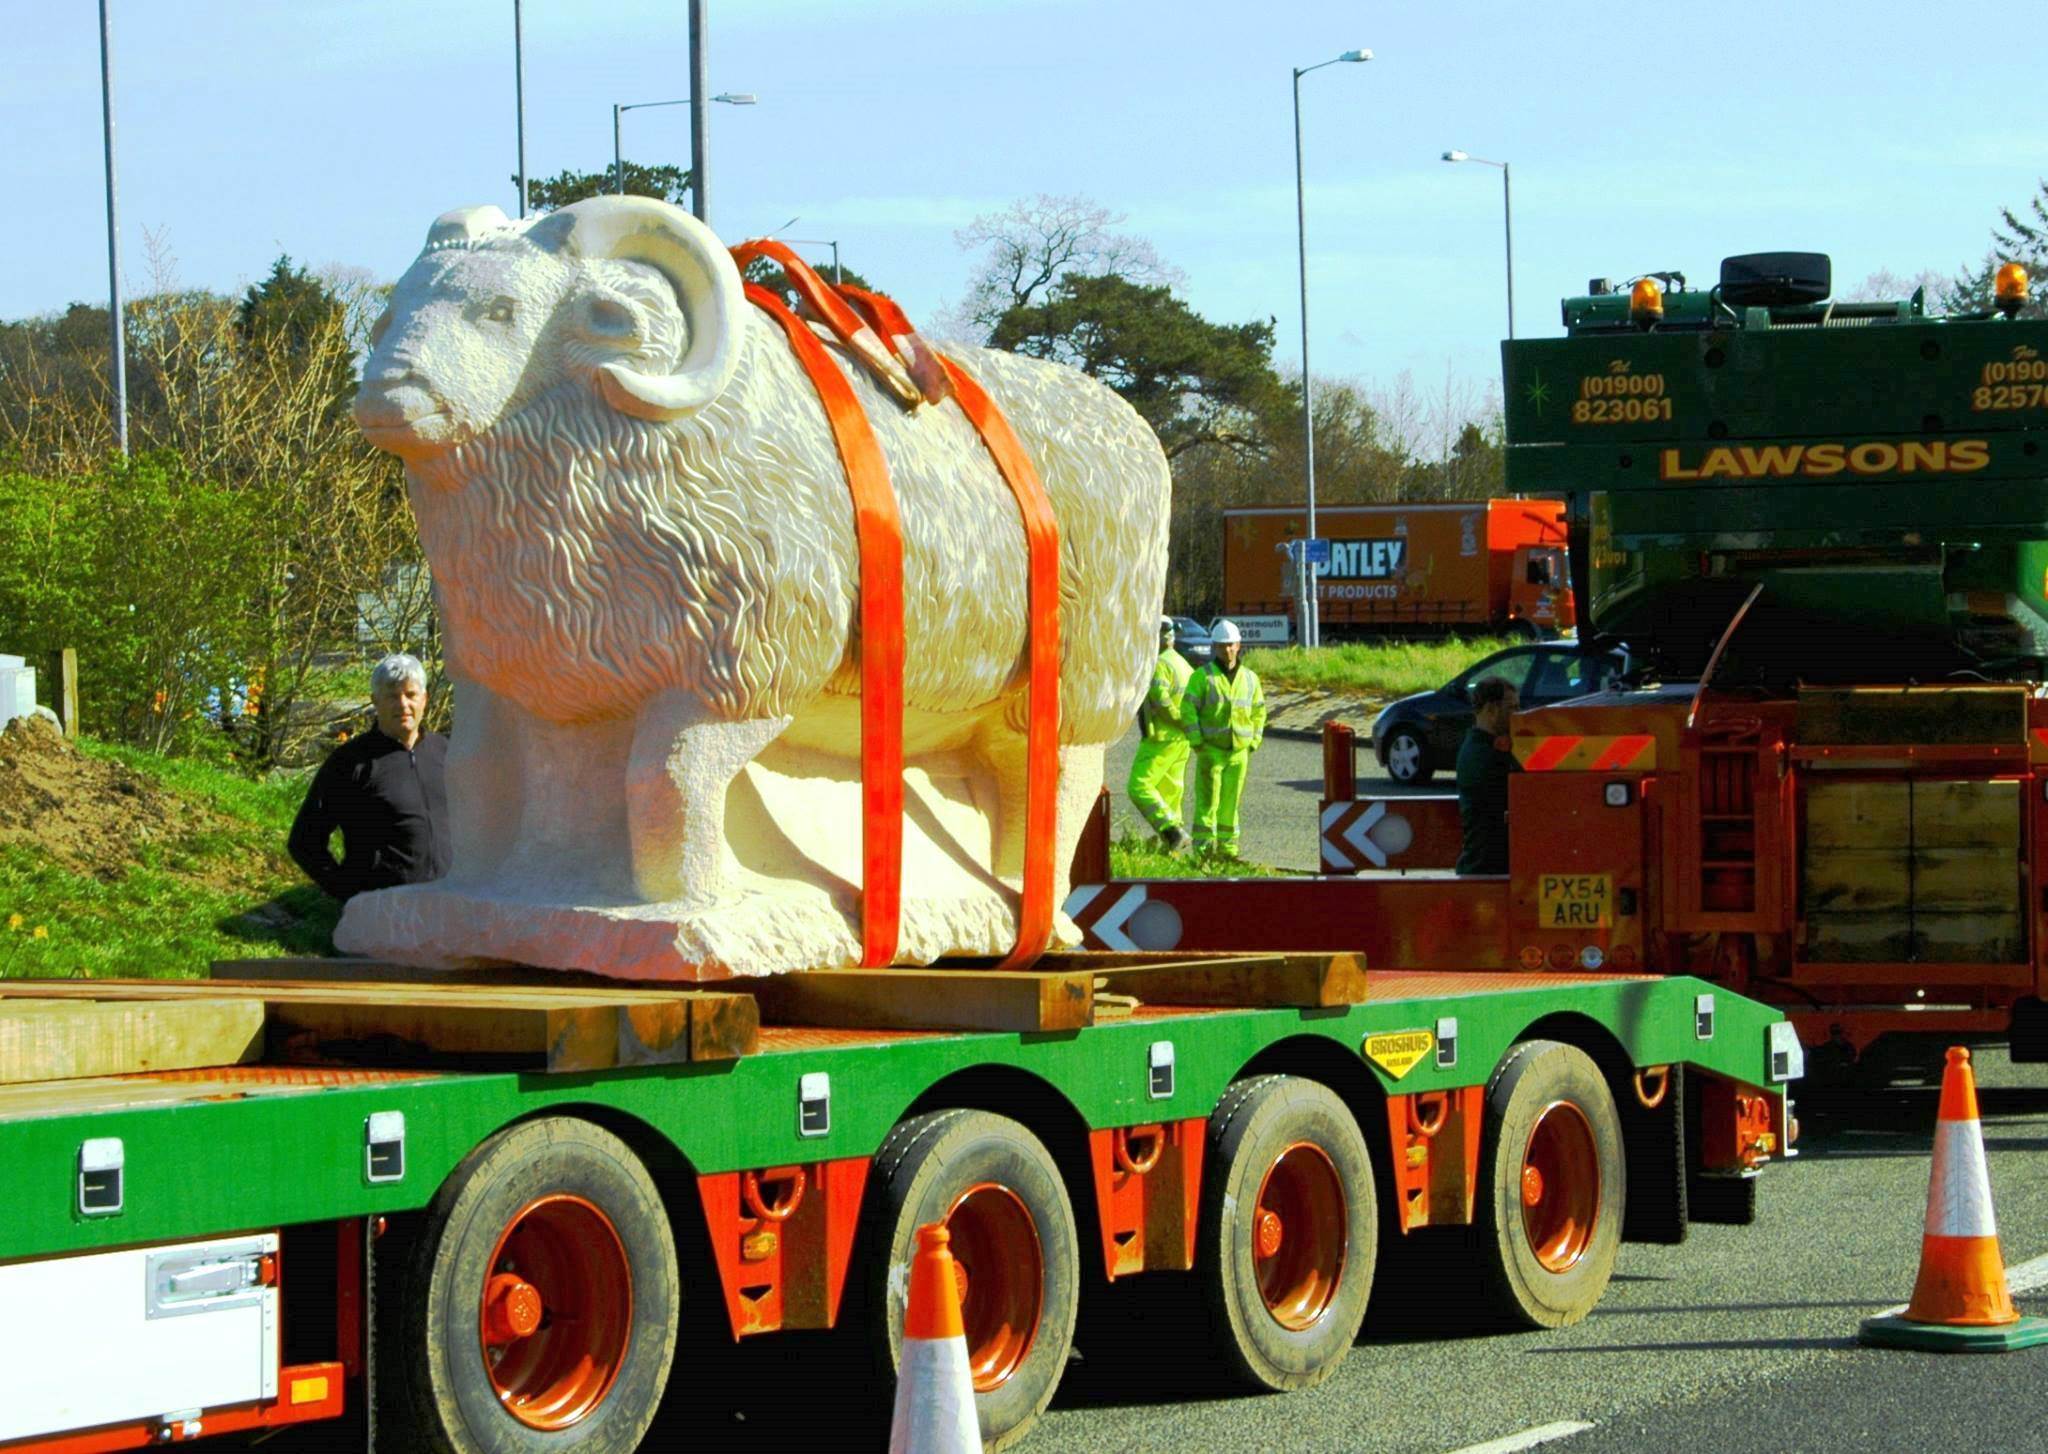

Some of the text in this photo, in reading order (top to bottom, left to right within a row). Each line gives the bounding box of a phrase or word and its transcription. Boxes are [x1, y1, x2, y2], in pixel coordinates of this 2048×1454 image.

[1982, 360, 2048, 386] (0190
[1582, 373, 1665, 399] (01900)
[1573, 397, 1672, 423] 823061
[1662, 439, 1991, 479] LAWSONS
[1328, 584, 1398, 599] PRODUCTS
[1543, 878, 1606, 899] PX54
[1553, 902, 1601, 924] ARU
[1370, 1034, 1430, 1056] BROSHUIS
